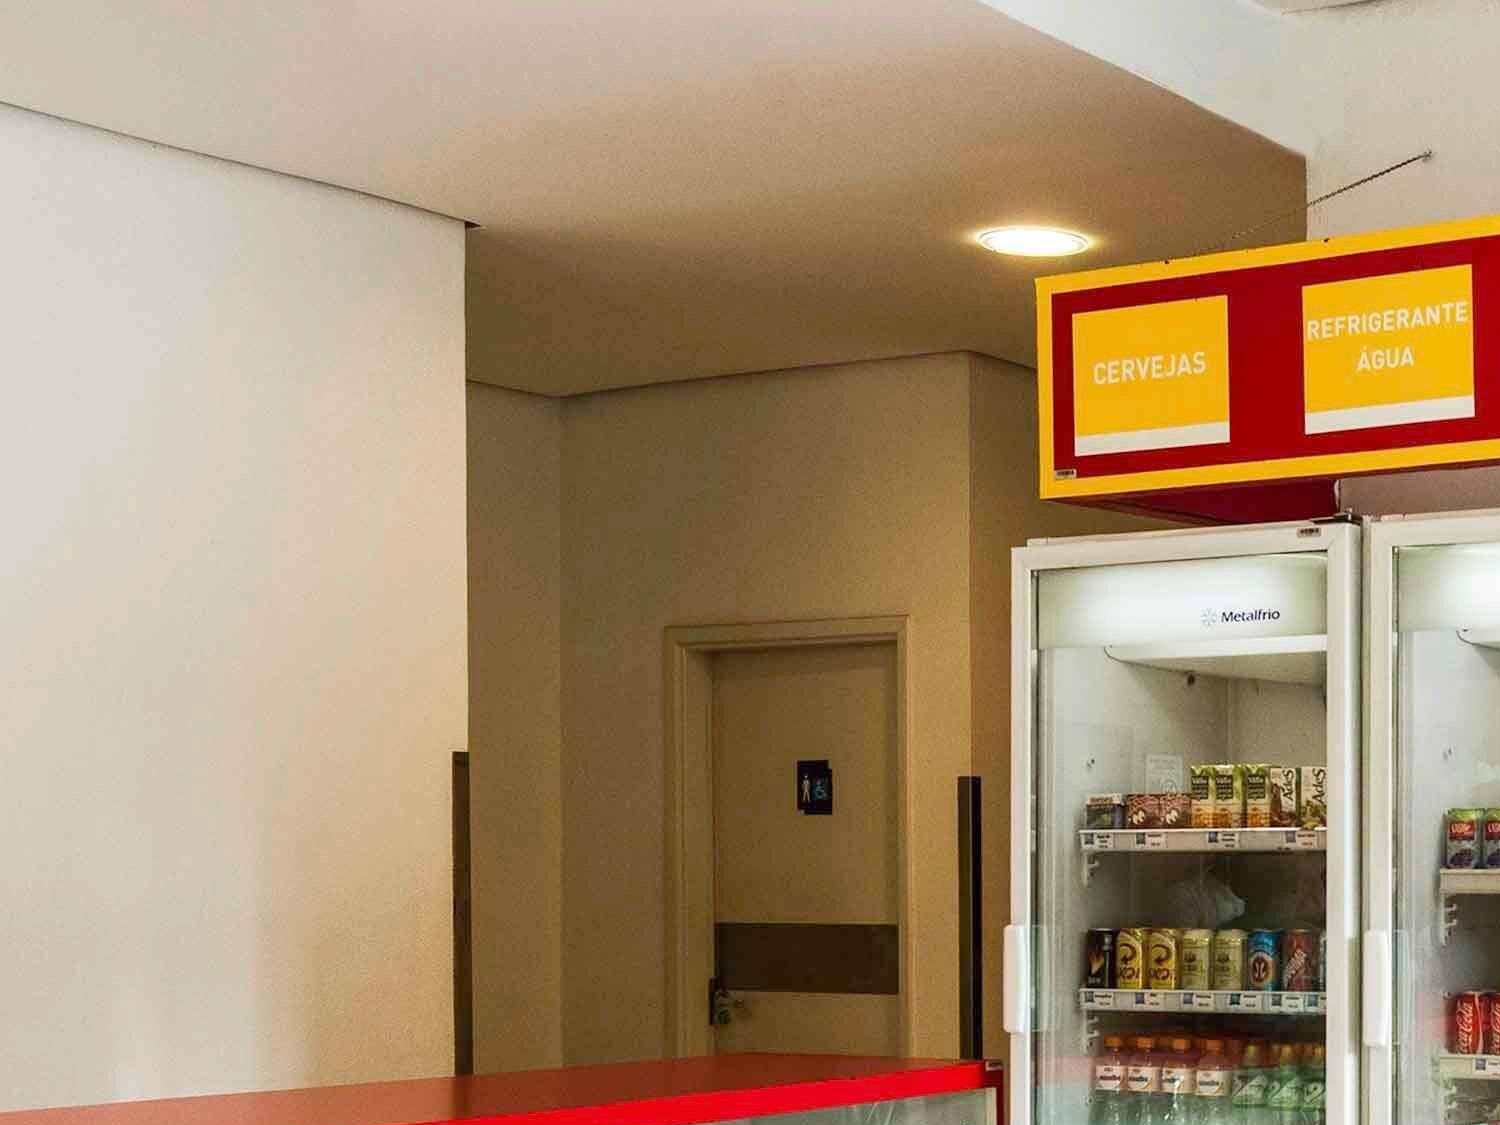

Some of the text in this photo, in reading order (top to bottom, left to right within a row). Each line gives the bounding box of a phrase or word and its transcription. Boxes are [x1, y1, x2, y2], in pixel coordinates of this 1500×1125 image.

[1306, 300, 1469, 341] REFRIGERANTE
[1092, 350, 1207, 385] CERVEJAS
[1356, 345, 1415, 373] ÁGUA
[1220, 606, 1281, 623] Metalfrio
